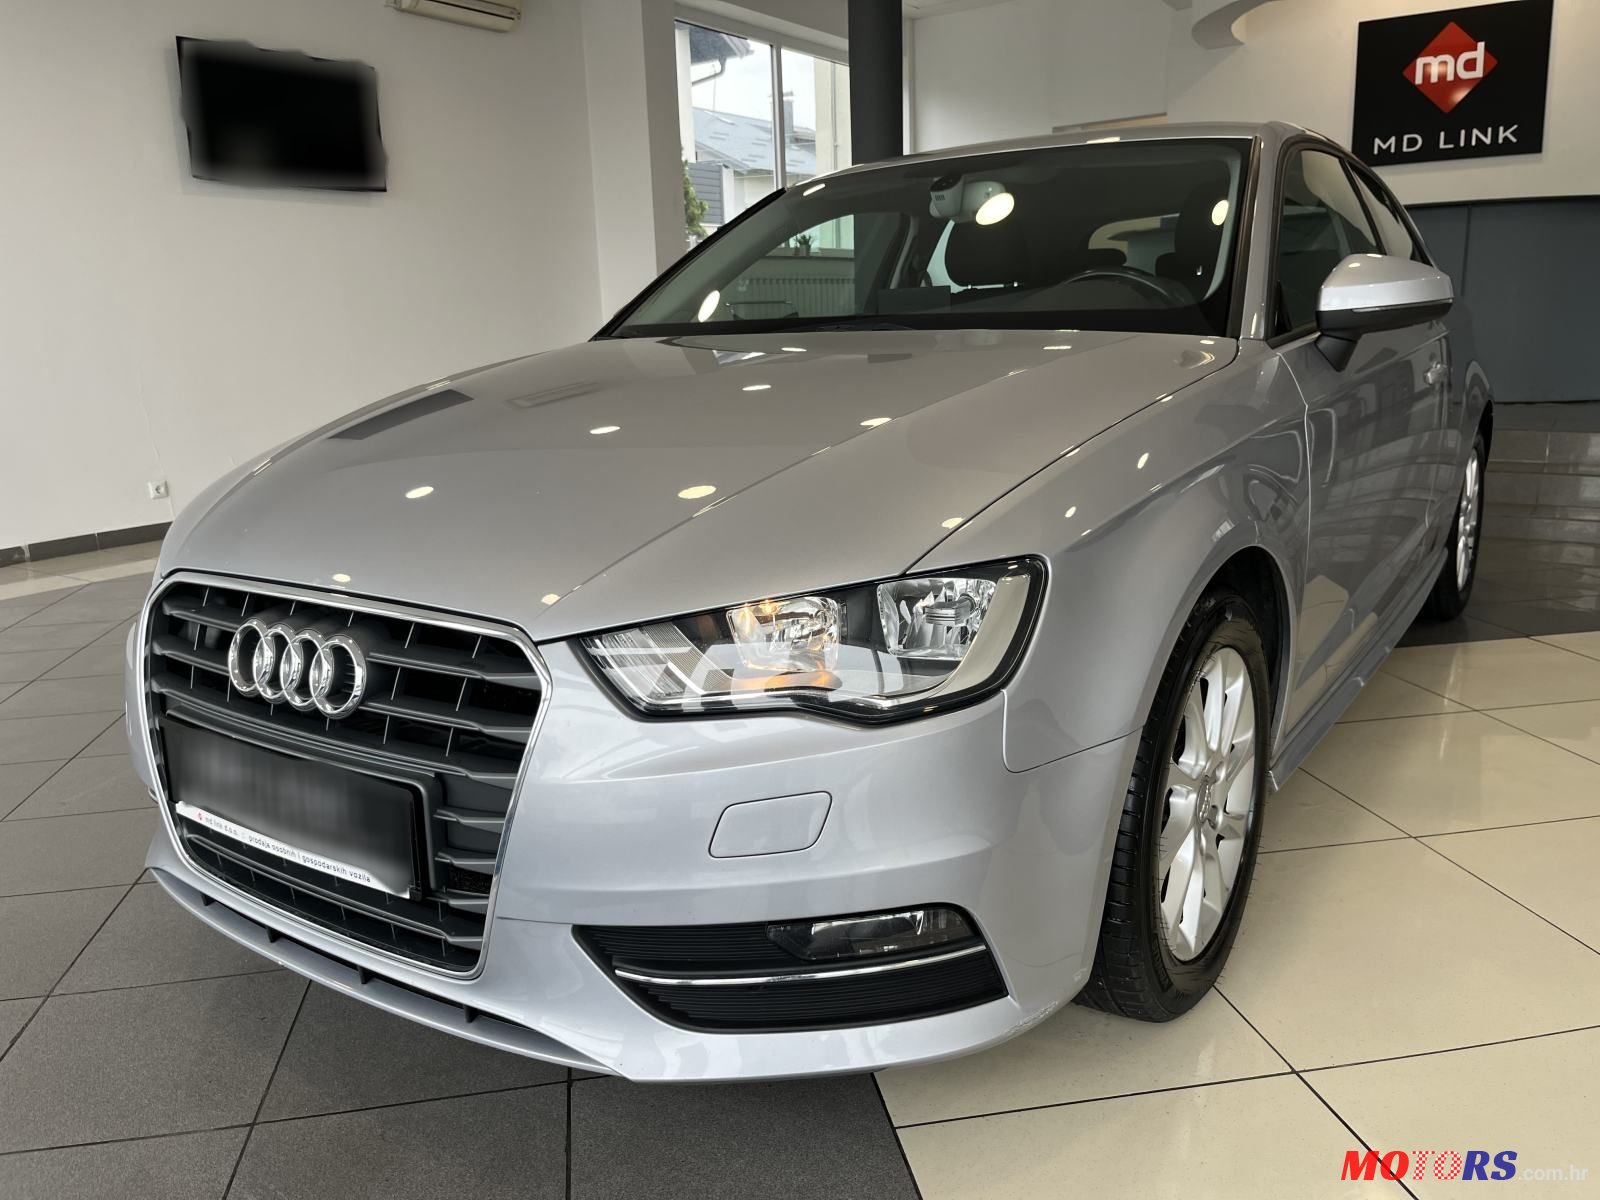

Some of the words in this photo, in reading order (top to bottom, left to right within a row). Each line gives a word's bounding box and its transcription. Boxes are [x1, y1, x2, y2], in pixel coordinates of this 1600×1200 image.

[1415, 41, 1485, 85] md
[1373, 133, 1423, 155] MD
[1439, 124, 1519, 149] LINK
[248, 835, 271, 850] prodaja
[302, 854, 347, 876] gospodarskih
[349, 869, 371, 883] vozila
